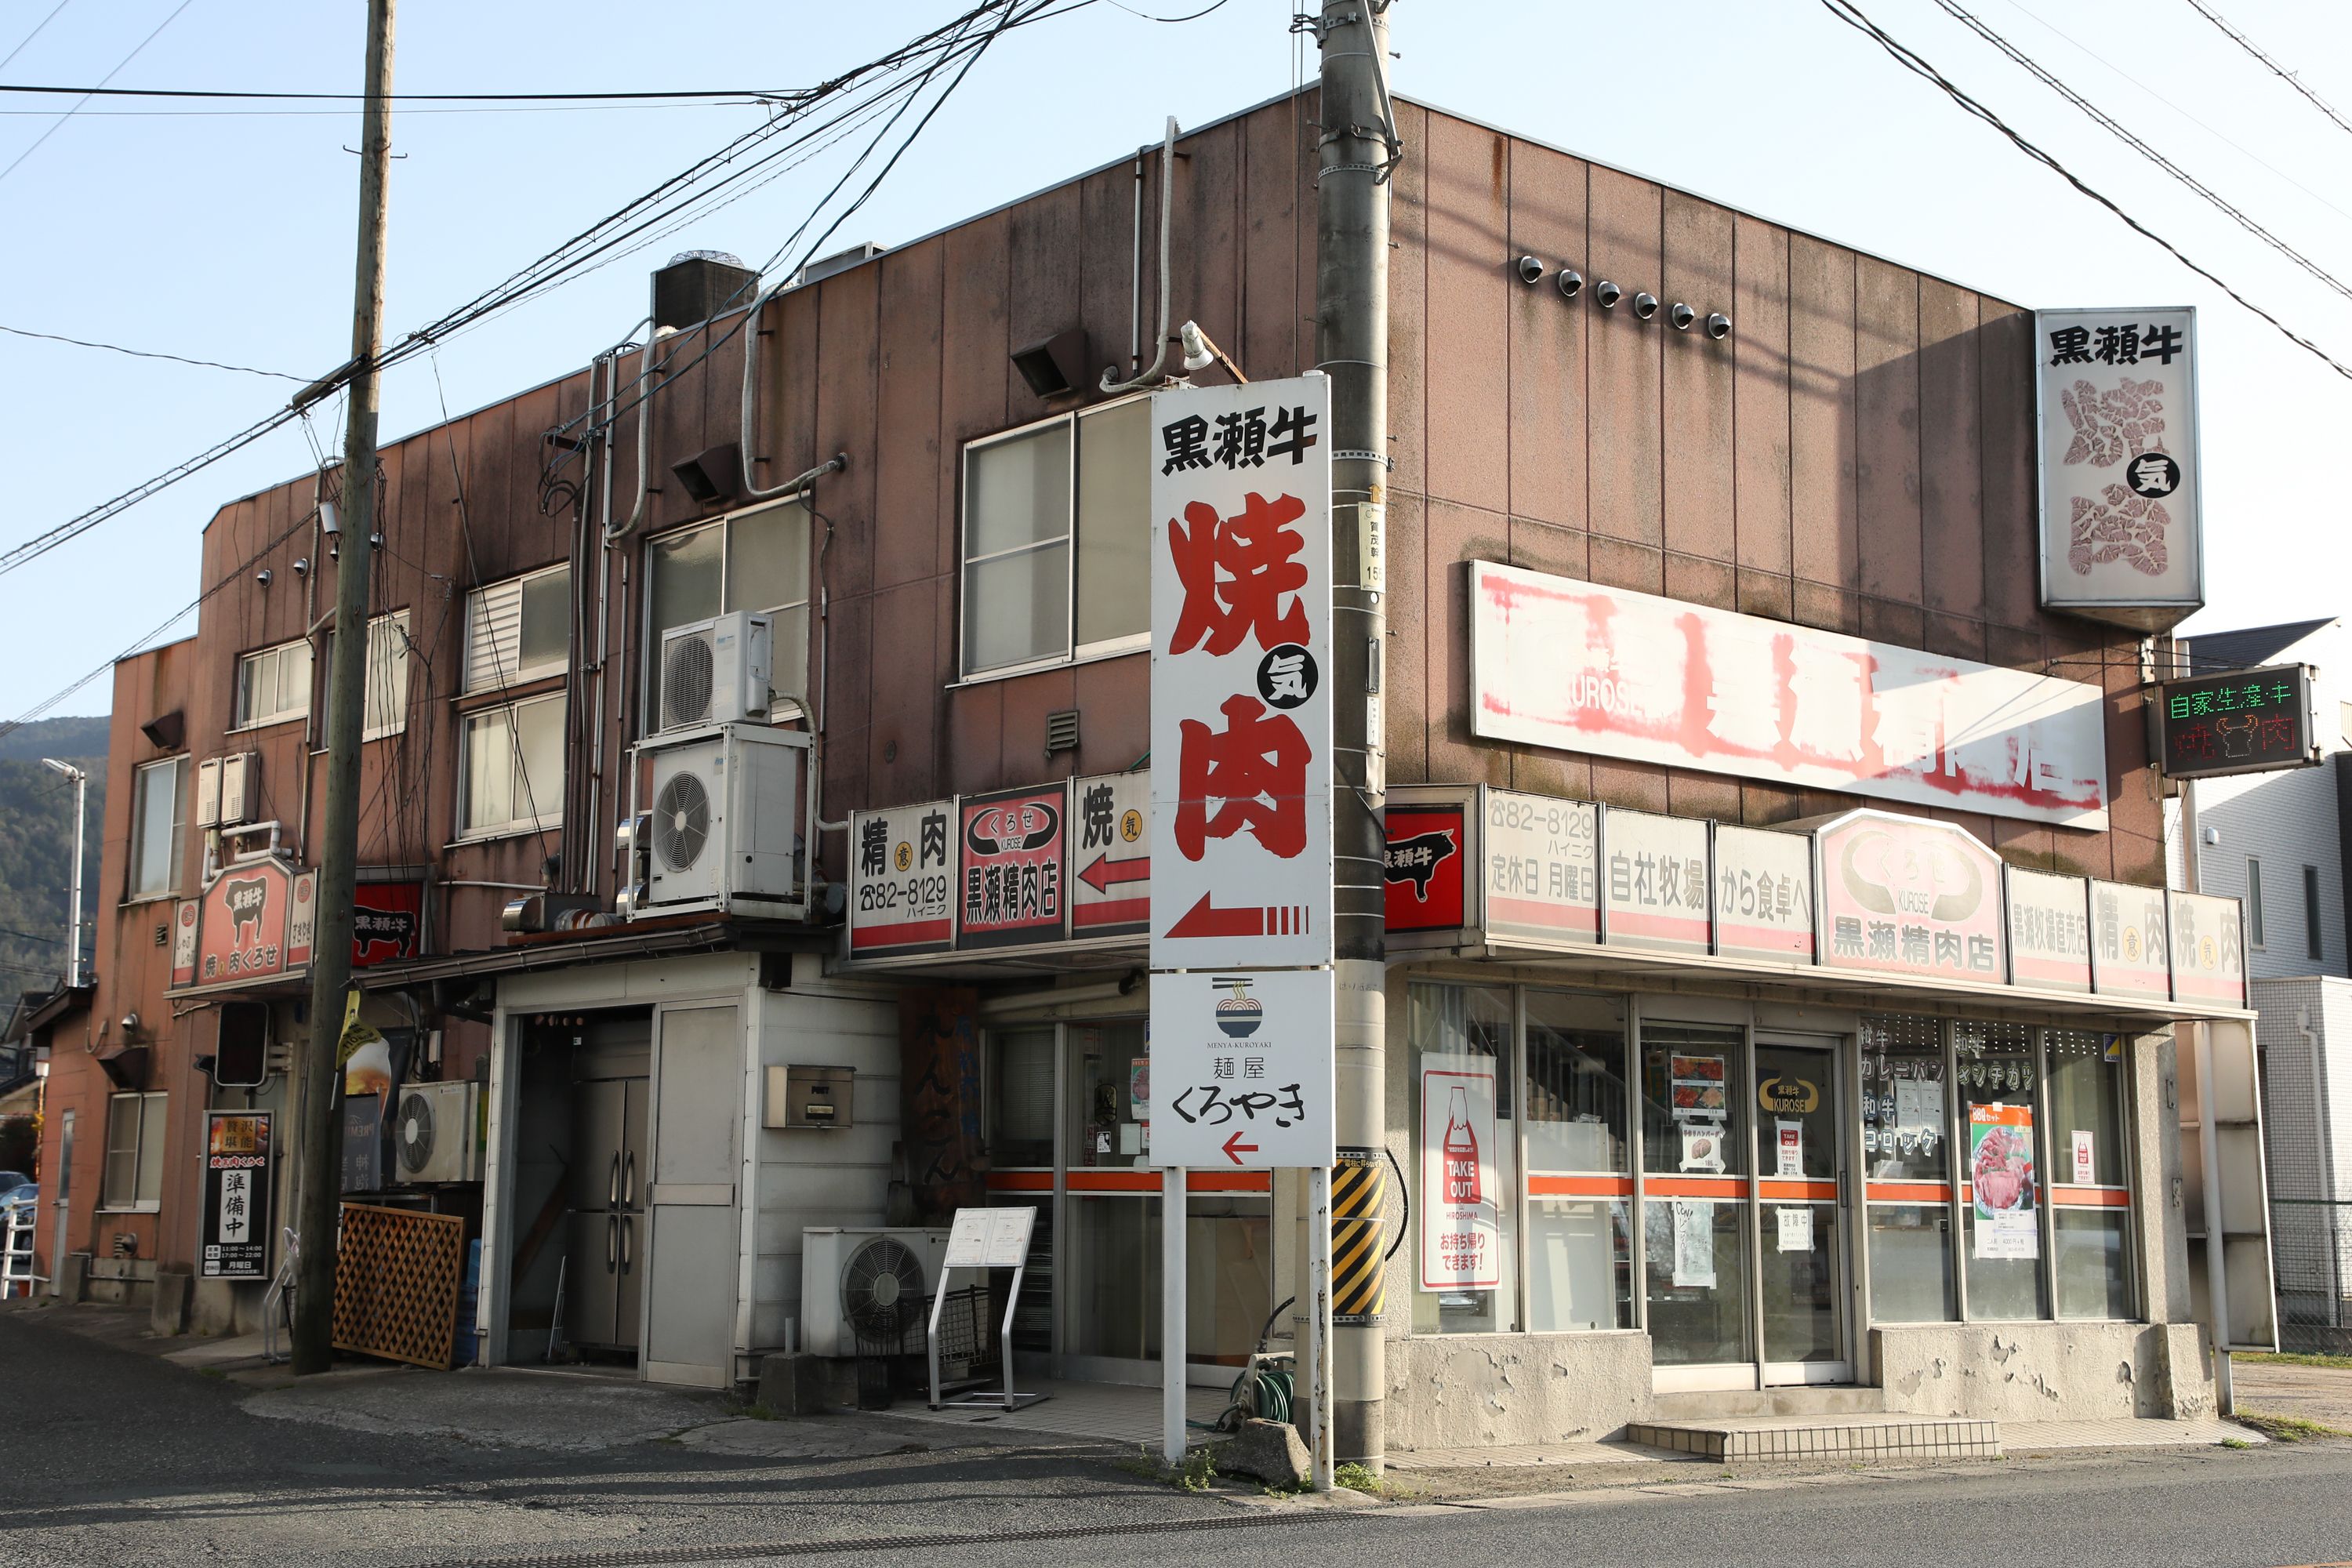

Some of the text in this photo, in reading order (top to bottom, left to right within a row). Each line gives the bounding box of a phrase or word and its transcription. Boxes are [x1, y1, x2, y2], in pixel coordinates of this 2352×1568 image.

[2049, 324, 2183, 367] 黒瀬牛
[1161, 406, 1318, 477] 黒瀬牛
[2136, 459, 2171, 492] 気
[1267, 653, 1308, 700] 気
[990, 811, 1034, 834] くろせ
[1124, 815, 1139, 837] 気
[1505, 800, 1594, 840] 82-8129
[897, 846, 909, 867] 意
[1000, 837, 1022, 852] KUROSE
[1548, 840, 1594, 860] ハイニク
[1491, 854, 1595, 903] 定休日 月曜日
[1610, 850, 1705, 910] 自社牧場
[234, 887, 263, 912] 黒瀬牛
[876, 876, 946, 910] 82-8129
[965, 858, 1058, 924] 黒瀬精肉店
[1721, 866, 1809, 924] から食卓へ
[1898, 890, 1929, 914] KUROSE
[354, 915, 408, 932] 黒瀬牛
[906, 904, 947, 919] ハイニク
[2013, 903, 2087, 956] 黒瀬牧場直売店
[1834, 916, 1994, 971] 黒瀬精肉店
[2125, 932, 2139, 957] 意
[2202, 942, 2214, 965] 気
[1214, 1057, 1265, 1079] 麺屋
[1860, 1054, 1944, 1082] カレーパン
[1958, 1066, 2034, 1087] メンチカツ
[1172, 1083, 1305, 1128] くろやき
[1773, 1098, 1806, 1112] KUROSE
[1864, 1095, 1894, 1118] 和牛
[1865, 1129, 1935, 1152] コロッケ
[1446, 1160, 1475, 1177] TAKE
[1450, 1181, 1473, 1198] OUT
[225, 1173, 245, 1238] 準備中
[1440, 1232, 1485, 1250] お持ち帰り
[1443, 1253, 1483, 1271] できます!
